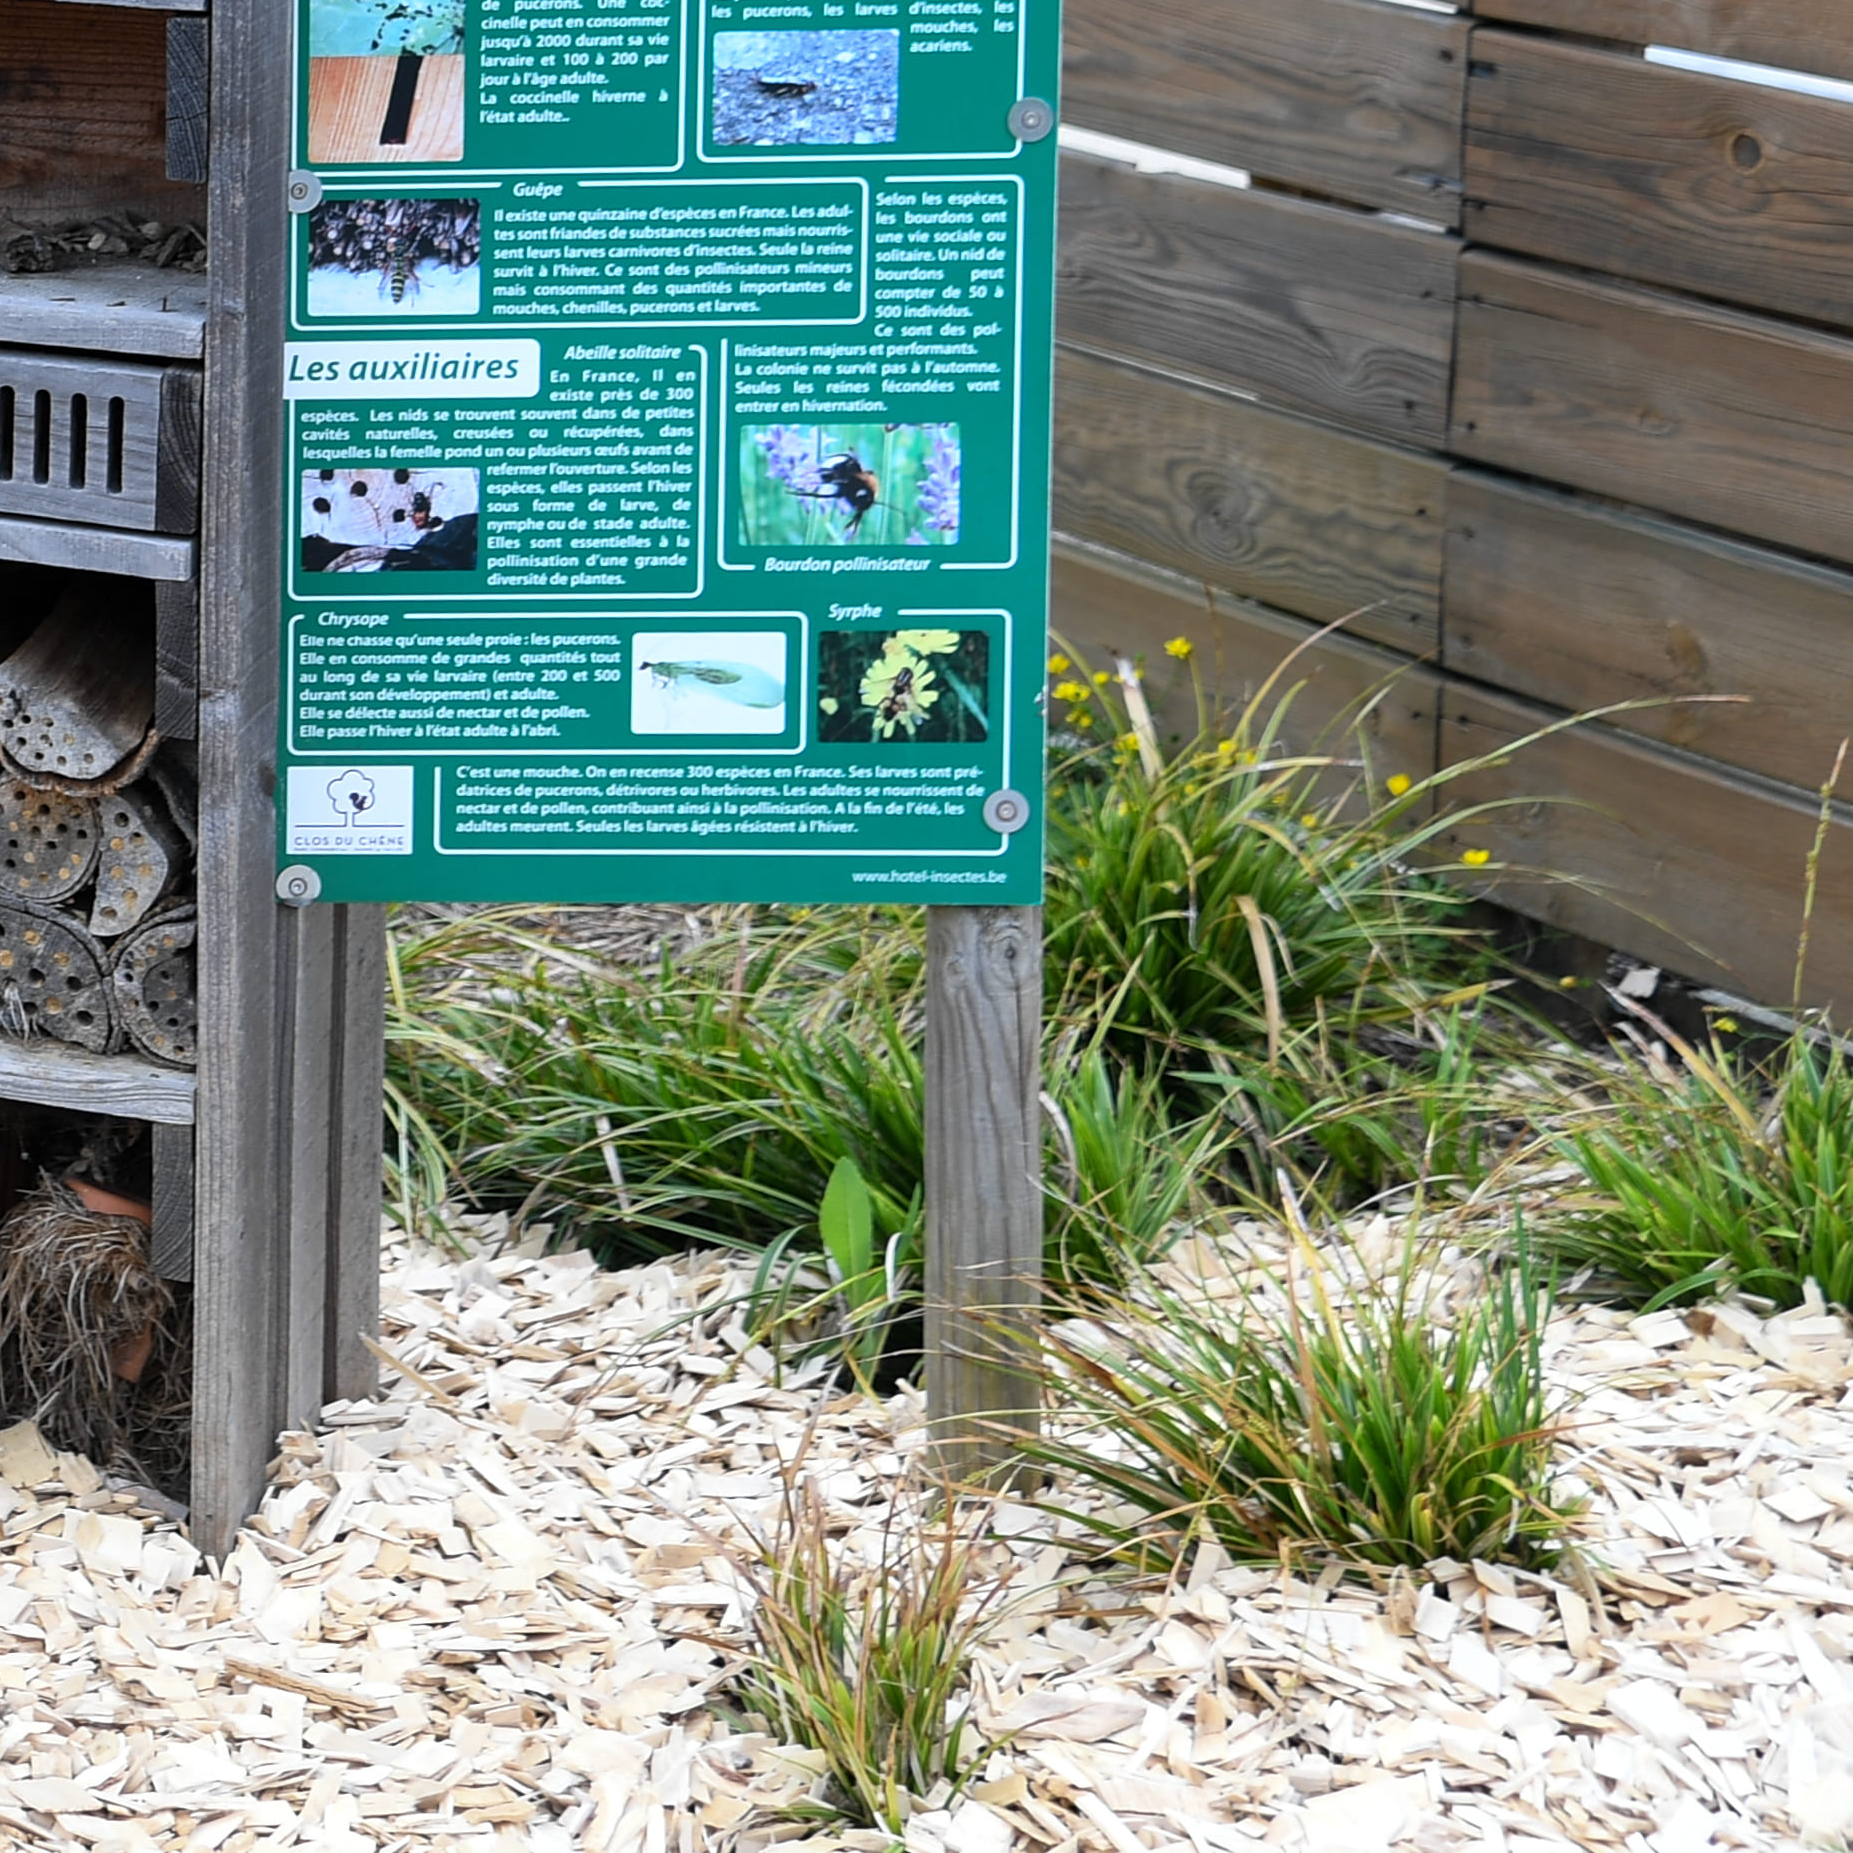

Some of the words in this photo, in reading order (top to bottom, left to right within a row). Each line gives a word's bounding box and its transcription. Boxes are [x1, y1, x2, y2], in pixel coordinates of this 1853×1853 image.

[712, 5, 731, 17] les
[824, 3, 843, 16] les
[855, 2, 897, 15] larves
[994, 0, 1014, 13] les
[481, 16, 527, 29] cinelle
[530, 17, 563, 31] peut
[565, 18, 584, 28] en
[586, 16, 669, 28] consommer
[994, 19, 1013, 31] les
[536, 34, 571, 47] 2000
[575, 33, 623, 46] durant
[628, 36, 643, 45] sa
[647, 33, 669, 45] vie
[481, 54, 533, 66] larvaire
[540, 54, 555, 66] et
[563, 53, 589, 65] 100
[595, 53, 604, 65] à
[611, 52, 637, 65] 200
[644, 54, 668, 66] par
[479, 73, 509, 88] jour
[512, 73, 520, 85] à
[481, 92, 496, 104] La
[509, 90, 579, 103] coccinelle
[592, 90, 645, 102] hiverne
[659, 89, 667, 101] à
[513, 182, 562, 198] Guêpe
[876, 192, 916, 205] Selon
[922, 192, 942, 205] les
[876, 211, 896, 224] les
[905, 210, 973, 224] bourdons
[982, 211, 1006, 222] ont
[875, 232, 903, 243] une
[908, 230, 929, 242] vie
[934, 229, 982, 242] sociale
[986, 231, 1006, 241] ou
[493, 265, 533, 277] survit
[539, 265, 547, 276] à
[605, 263, 623, 276] Ce
[628, 264, 659, 276] sont
[665, 262, 689, 275] des
[695, 261, 790, 277] pollinisateurs
[795, 261, 852, 273] mineurs
[875, 267, 943, 280] bourdons
[971, 267, 1004, 281] peut
[493, 283, 526, 296] mais
[533, 283, 625, 295] consommant
[632, 282, 657, 294] des
[665, 281, 731, 296] quantités
[739, 280, 825, 295] importantes
[833, 279, 852, 292] de
[874, 287, 935, 301] compter
[942, 285, 961, 298] de
[969, 285, 987, 298] 50
[994, 286, 1003, 297] à
[630, 302, 695, 315] pucerons
[697, 301, 712, 312] et
[564, 345, 617, 359] Abeille
[619, 344, 681, 359] solitaire
[288, 354, 339, 381] Les
[348, 351, 518, 380] auxiliaires
[550, 370, 569, 382] En
[675, 371, 695, 381] en
[549, 388, 593, 401] existe
[600, 388, 632, 403] près
[639, 387, 659, 400] de
[666, 387, 693, 400] 300
[551, 480, 583, 493] elles
[588, 481, 642, 495] passent
[765, 556, 831, 571] Bourdon
[832, 556, 930, 573] pollinisateur
[828, 603, 881, 620] Syrphe
[318, 612, 388, 628] Chrysope
[299, 652, 324, 664] Elle
[329, 655, 346, 664] en
[351, 654, 427, 664] consomme
[431, 652, 450, 663] de
[454, 651, 510, 666] grandes
[520, 651, 586, 665] quantités
[591, 652, 620, 663] tout
